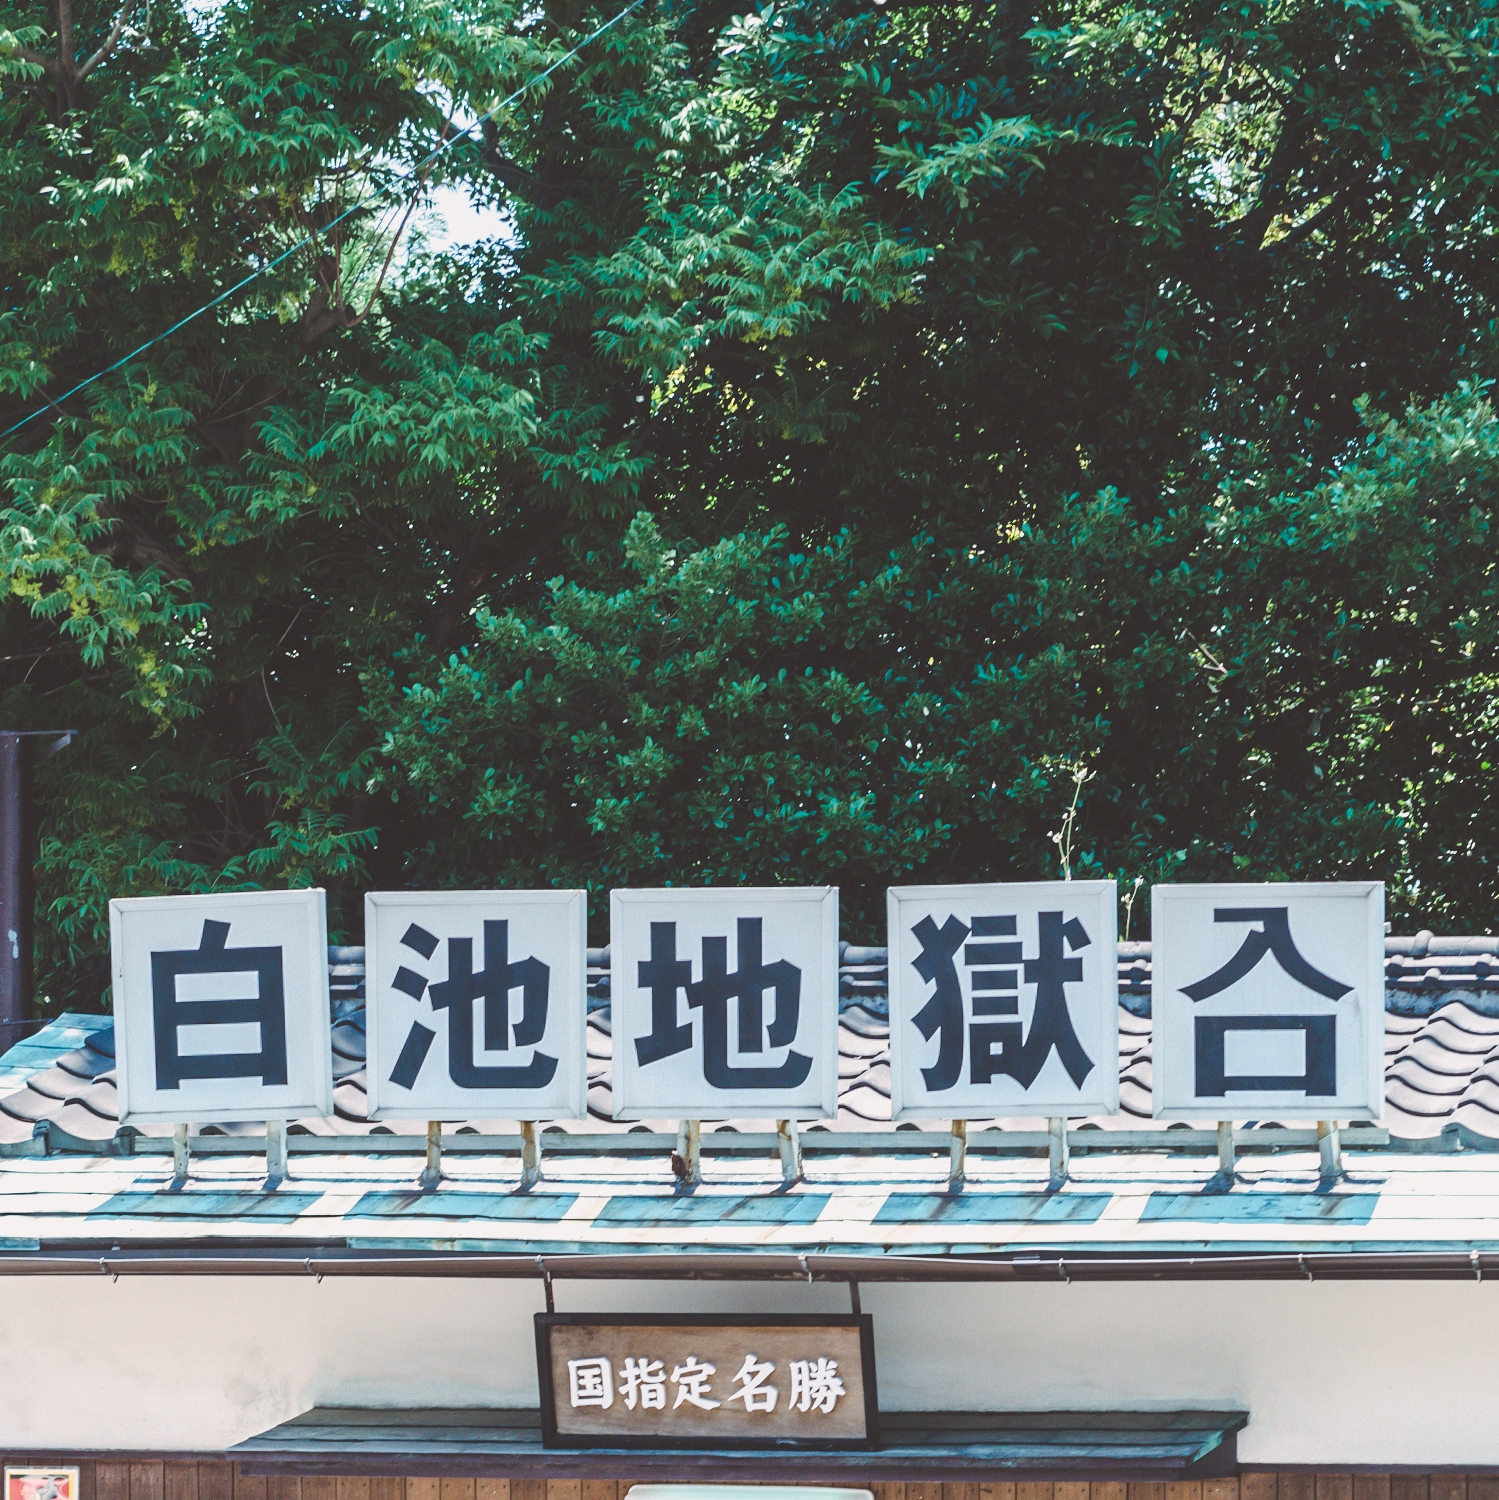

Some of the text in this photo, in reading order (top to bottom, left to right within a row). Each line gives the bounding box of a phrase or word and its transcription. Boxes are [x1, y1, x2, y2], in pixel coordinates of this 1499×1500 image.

[566, 1353, 848, 1416] 国指定名勝
